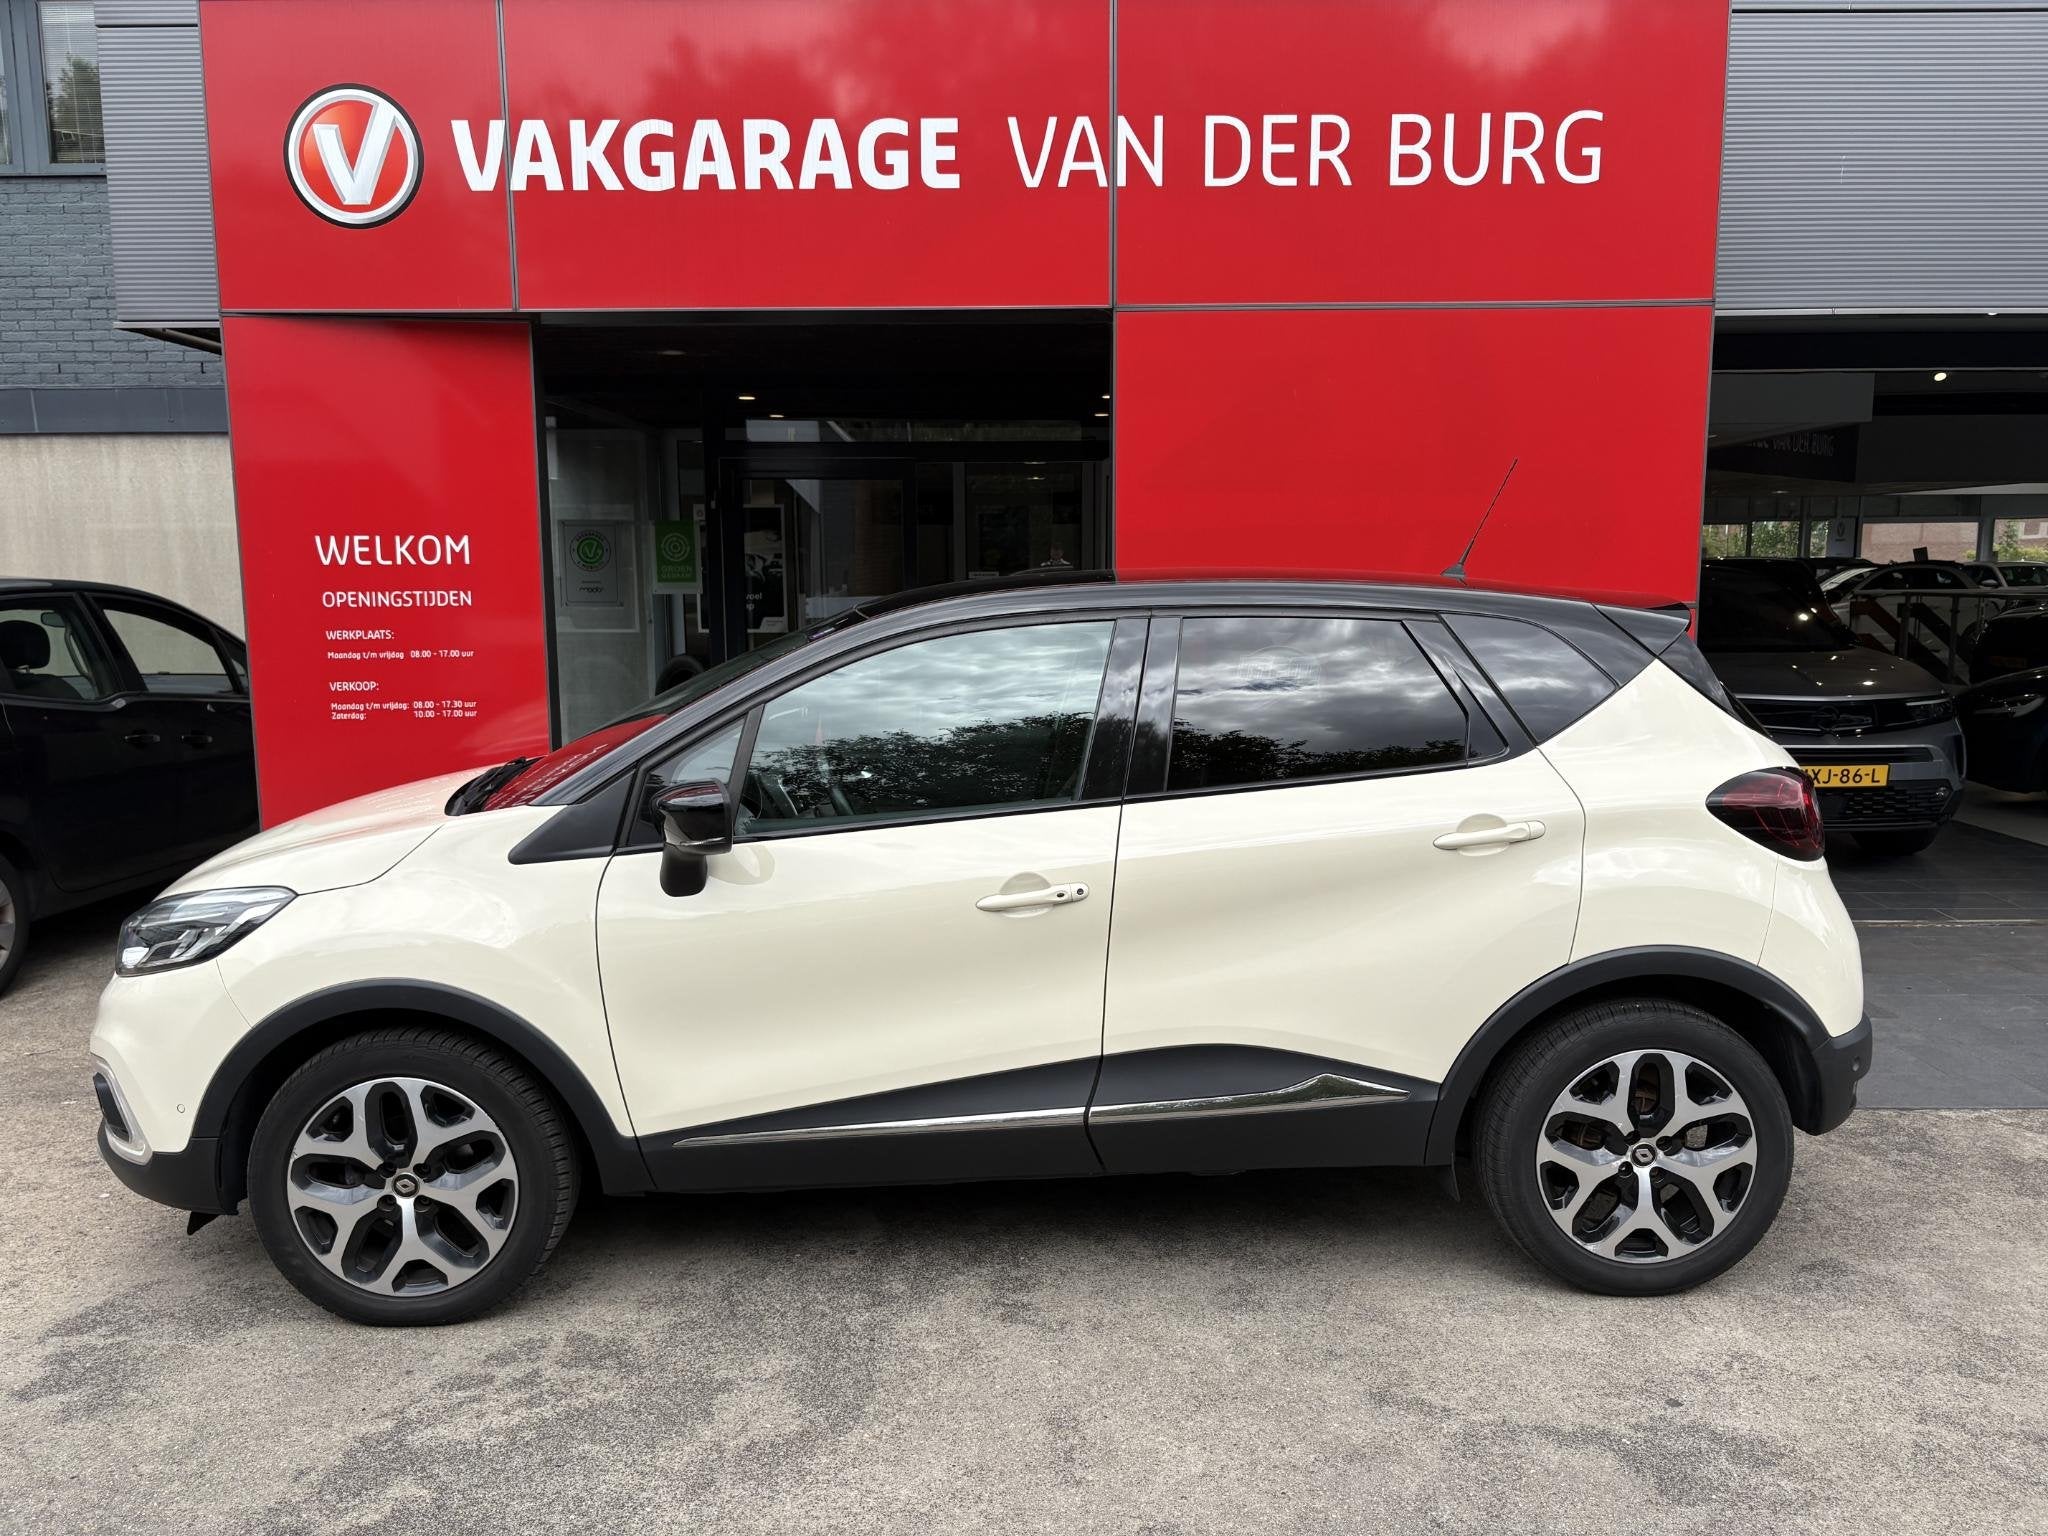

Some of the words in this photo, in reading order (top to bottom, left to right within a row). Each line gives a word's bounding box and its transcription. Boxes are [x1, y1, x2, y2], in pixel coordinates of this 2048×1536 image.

[451, 117, 960, 192] VAKGARAGE
[1007, 115, 1164, 188] VAN
[1204, 114, 1353, 187] DER
[1389, 110, 1604, 186] BURG
[314, 534, 471, 566] WELKOM
[322, 590, 473, 608] OPENINGSTIJDEN
[325, 629, 395, 640] WERKPLAATS:
[327, 651, 361, 660] Maandag
[363, 650, 378, 659] t/m
[379, 650, 405, 660] vrijdag
[410, 650, 432, 658] 08.00
[439, 649, 460, 658] 17.00
[329, 681, 379, 692] VERKOOP:
[331, 702, 365, 712] Maandag
[366, 702, 381, 710] t/m
[382, 702, 410, 712] vrijdag:
[413, 701, 435, 709] 08.00
[442, 700, 463, 708] 17.30
[331, 711, 367, 721] Zaterdag:
[414, 710, 435, 718] 10.00
[443, 710, 463, 718] 17.00
[1805, 768, 1881, 784] XJ-86-L
